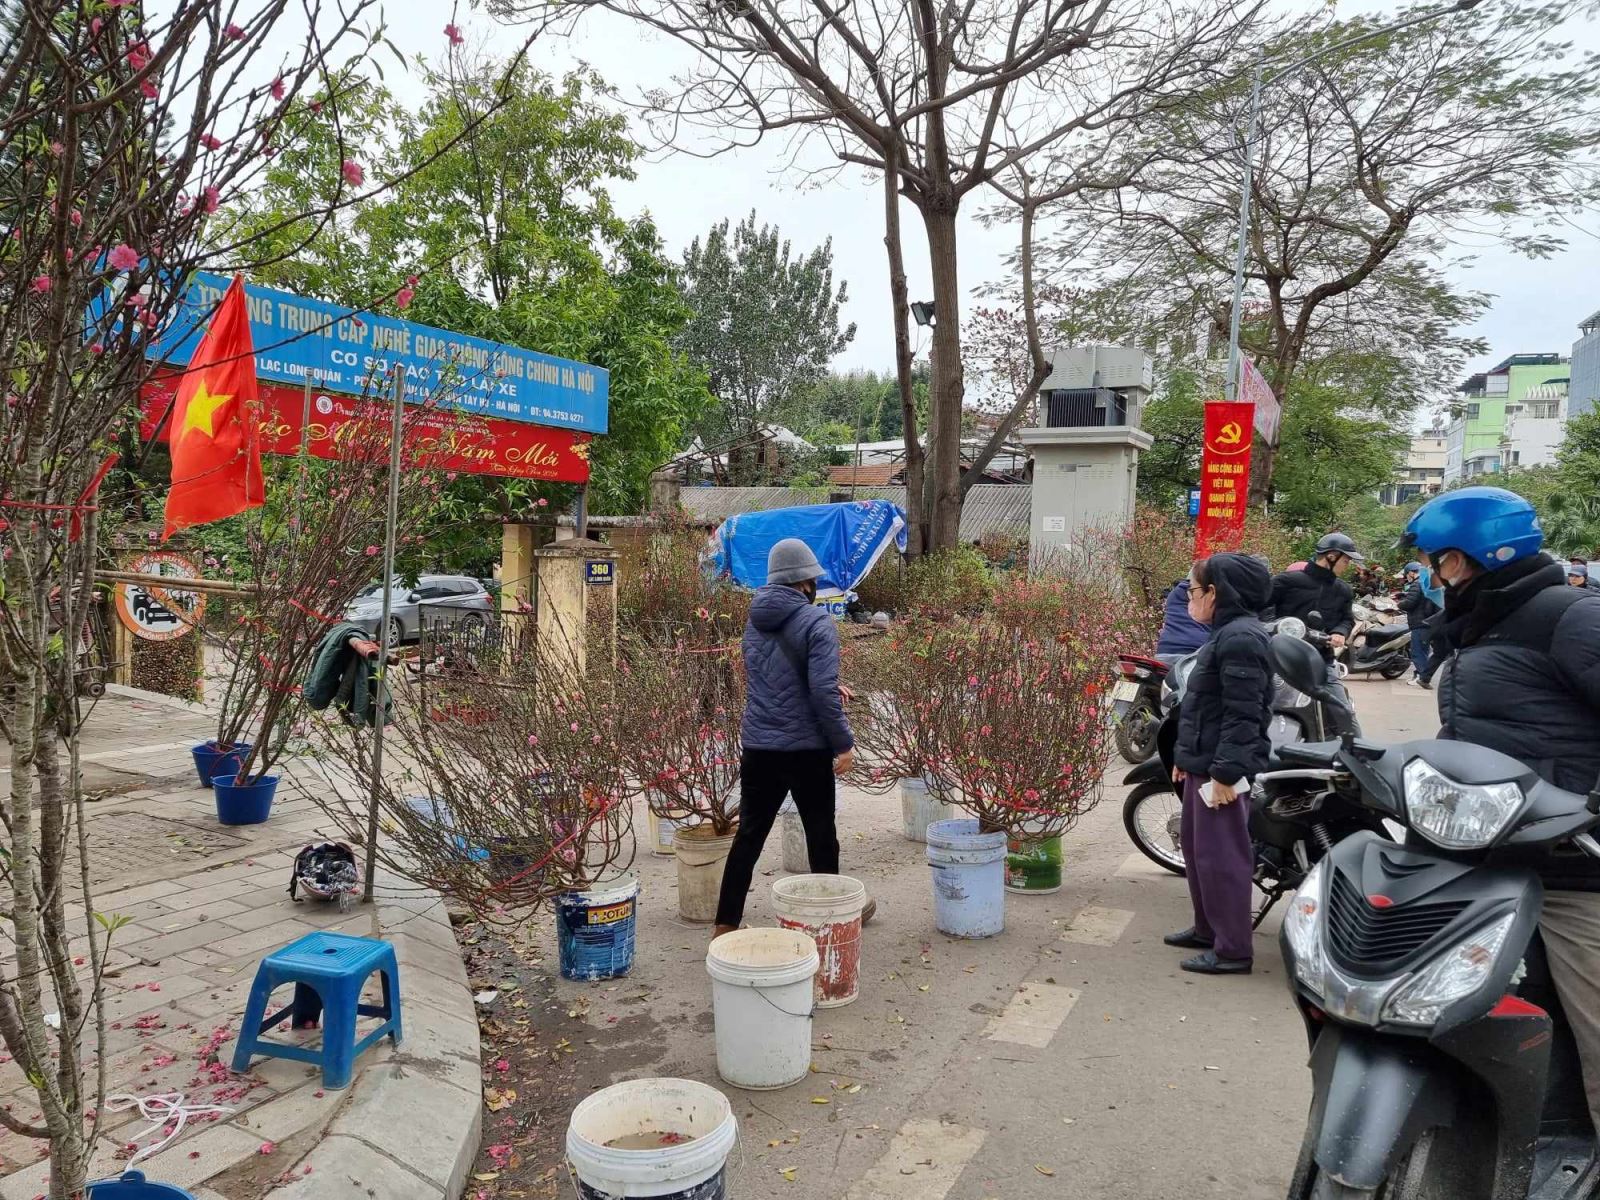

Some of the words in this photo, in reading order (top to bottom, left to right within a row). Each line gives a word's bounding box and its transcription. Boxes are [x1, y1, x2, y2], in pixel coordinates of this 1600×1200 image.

[198, 284, 273, 326] TRNG
[278, 302, 333, 338] TRUNG
[373, 322, 411, 356] NGHỀ
[415, 334, 446, 362] GIAO
[493, 350, 524, 378] CÔNG
[526, 358, 560, 386] CHÍNH
[561, 366, 576, 390] HÀ
[577, 369, 595, 396] NỘI
[260, 357, 281, 374] LẠC
[331, 349, 358, 367] CƠ
[435, 368, 467, 388] TO
[498, 382, 518, 397] XE
[505, 441, 559, 467] Mới
[591, 563, 609, 575] 360
